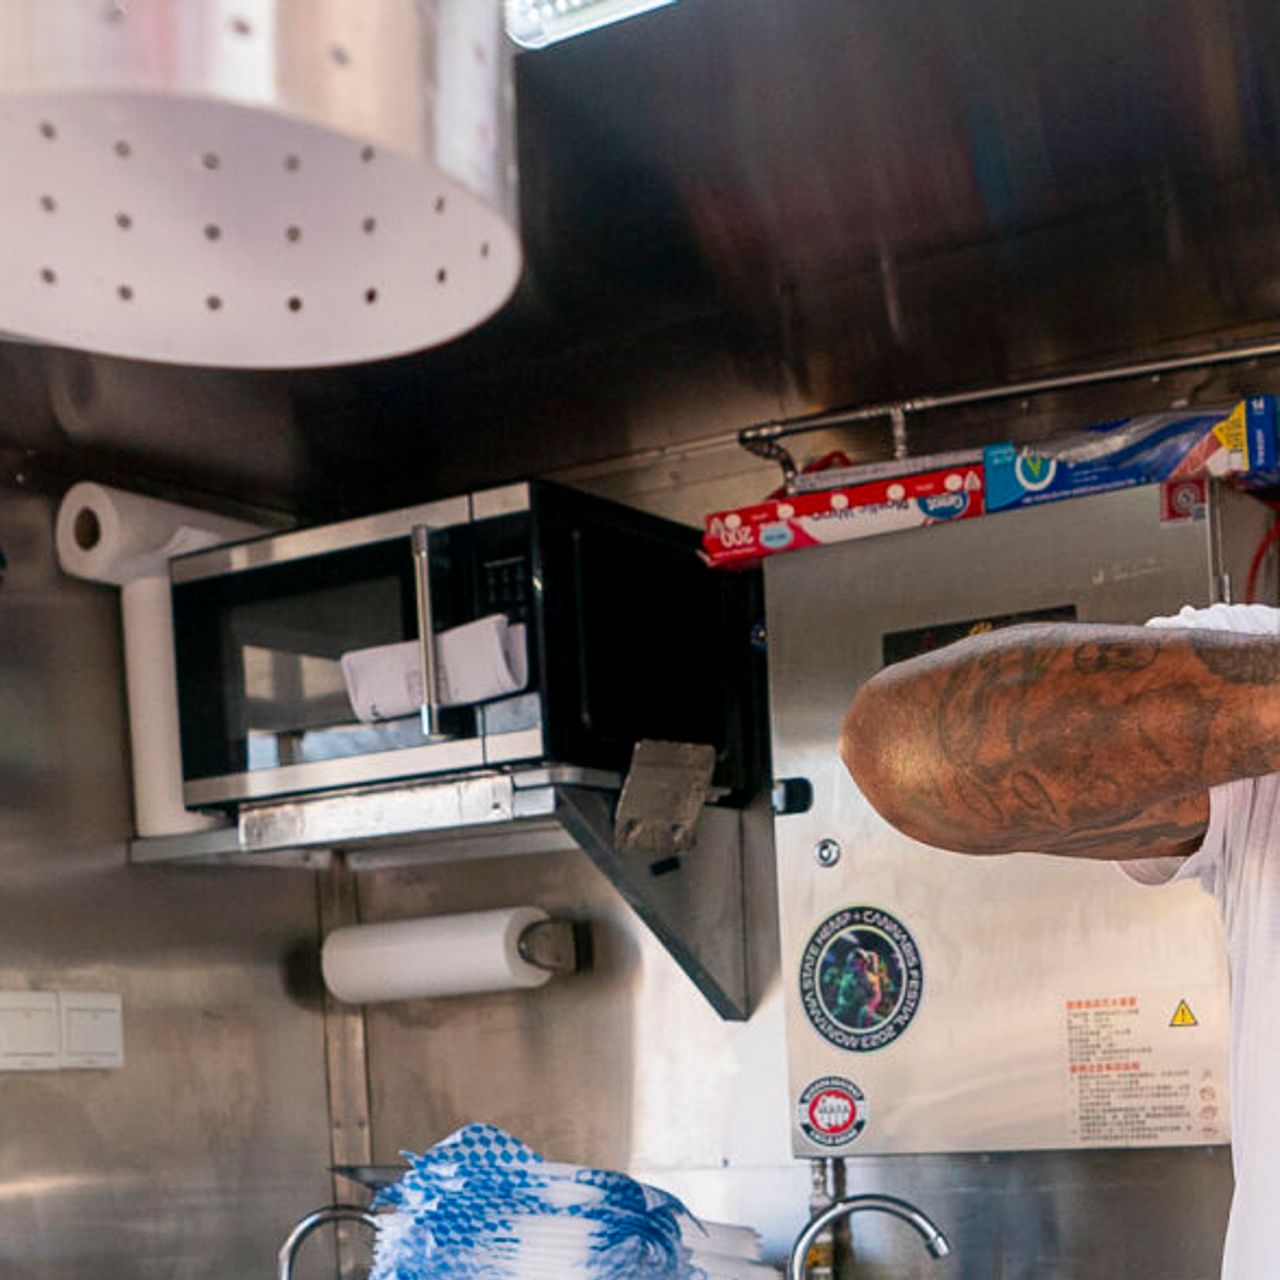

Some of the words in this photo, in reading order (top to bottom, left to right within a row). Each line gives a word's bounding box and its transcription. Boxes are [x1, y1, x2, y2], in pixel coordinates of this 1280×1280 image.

[815, 911, 851, 946] HEMP
[863, 910, 918, 967] CANNABIS
[802, 944, 820, 989] STATE
[804, 993, 858, 1048] MONTANA
